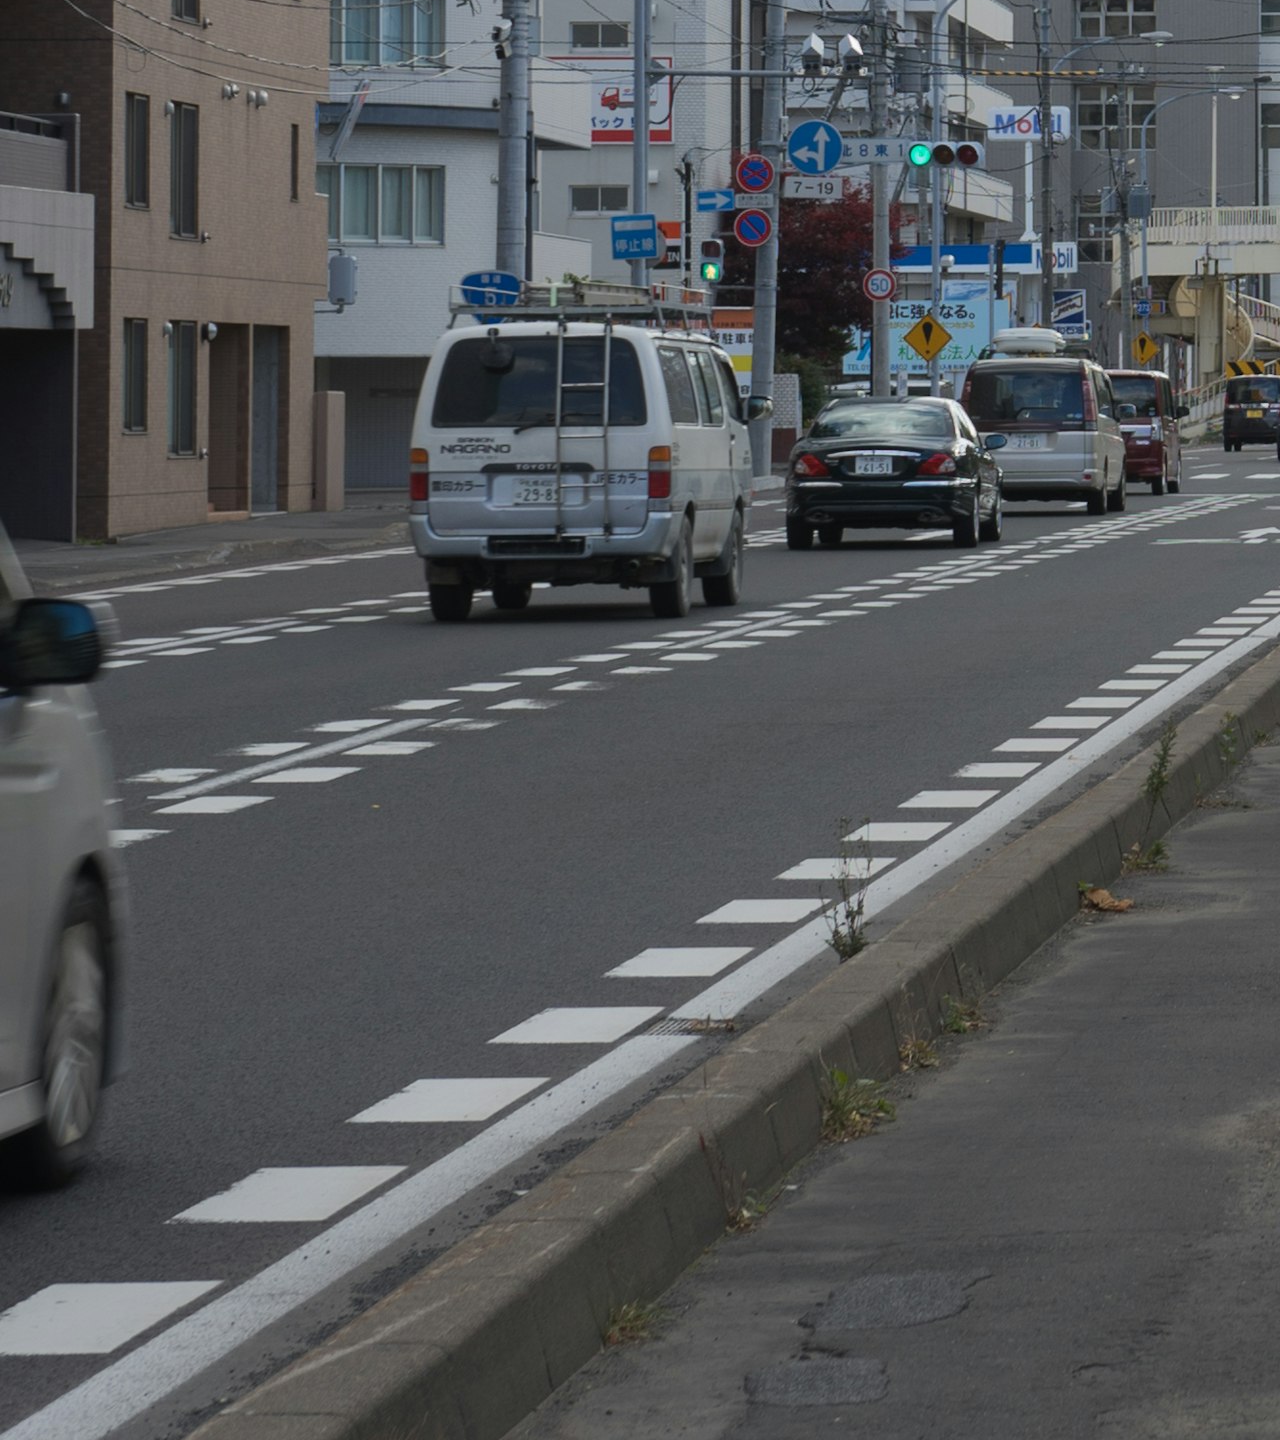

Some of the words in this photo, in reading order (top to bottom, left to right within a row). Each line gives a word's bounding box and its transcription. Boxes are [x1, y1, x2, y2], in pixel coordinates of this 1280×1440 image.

[793, 181, 834, 195] 7-19
[870, 278, 890, 292] 50
[440, 444, 511, 454] NAGANO
